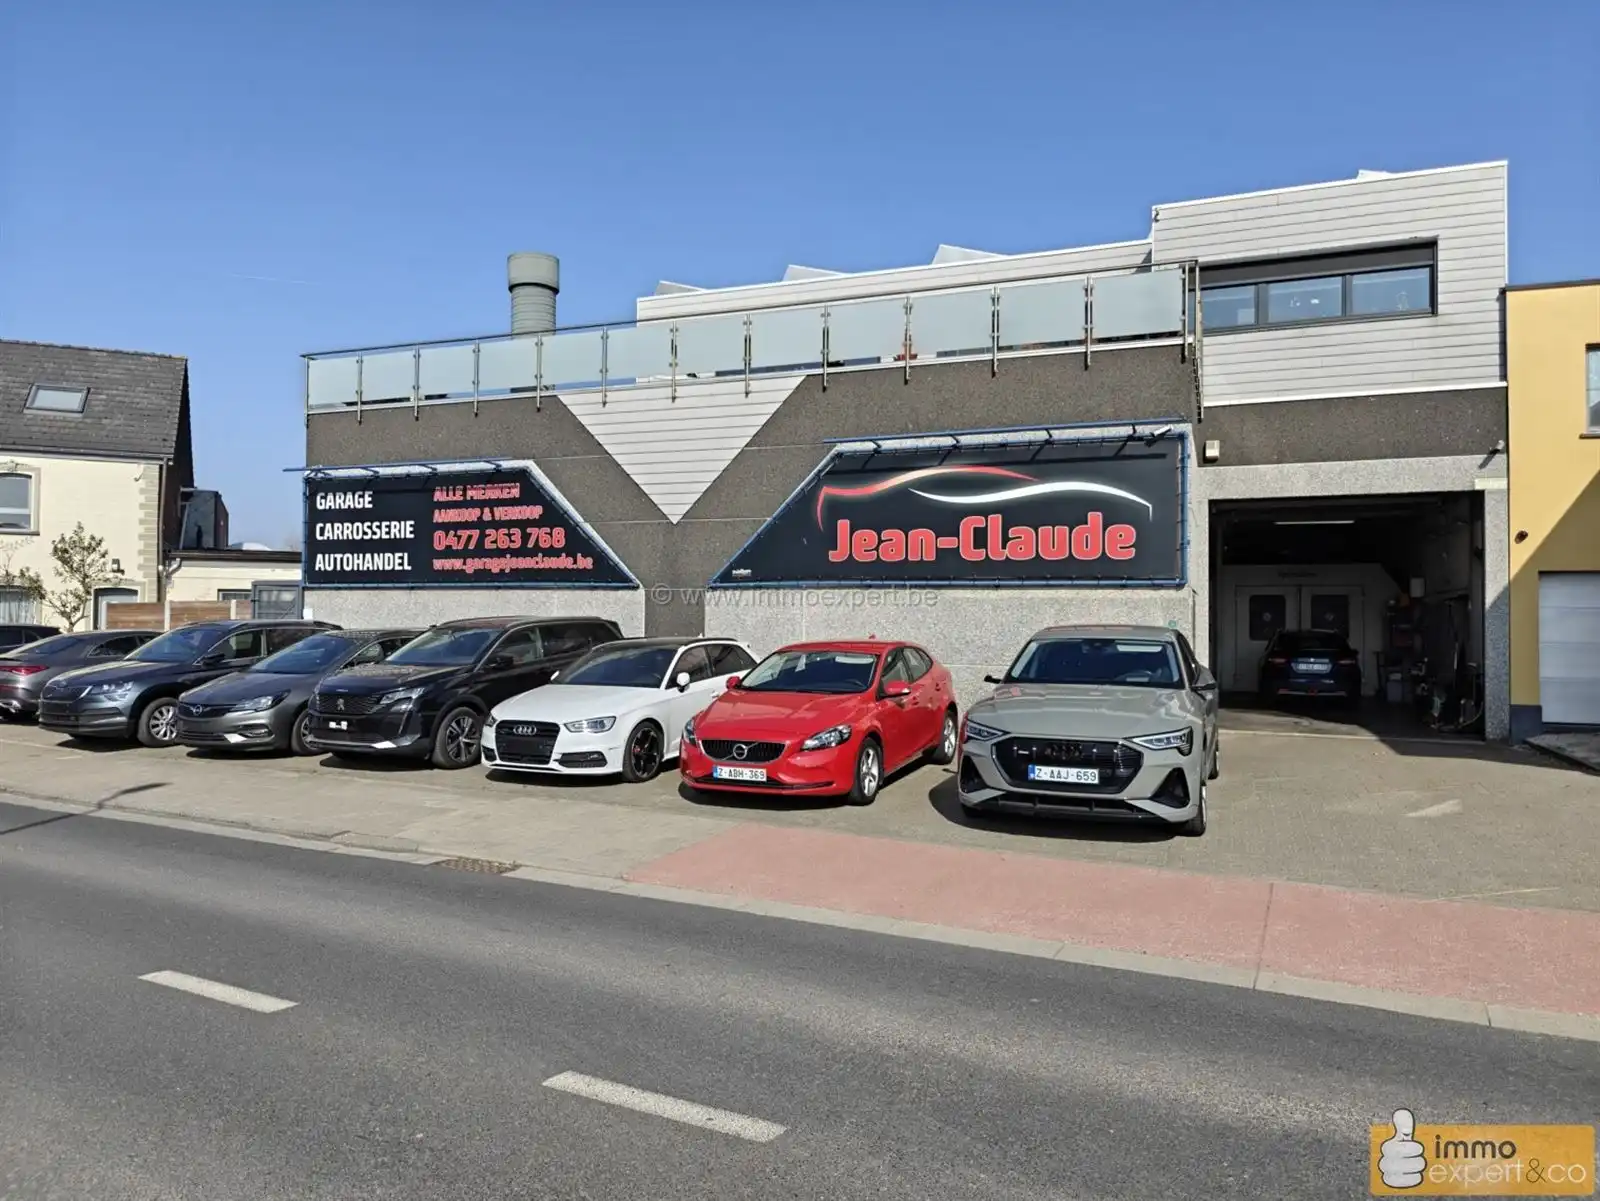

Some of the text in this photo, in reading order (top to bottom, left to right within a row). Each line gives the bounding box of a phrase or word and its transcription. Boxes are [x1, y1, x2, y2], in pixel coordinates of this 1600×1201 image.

[315, 490, 374, 510] GARAGE
[433, 486, 463, 502] ALLE
[483, 507, 492, 521] &
[494, 505, 543, 521] VERKOOP
[315, 520, 415, 541] CARROSSERIE
[433, 527, 566, 551] 0477 263 768
[828, 511, 1137, 562] Jean-Claude
[315, 552, 412, 571] AUTOHANDEL
[1036, 768, 1097, 782] Z-AAJ-659
